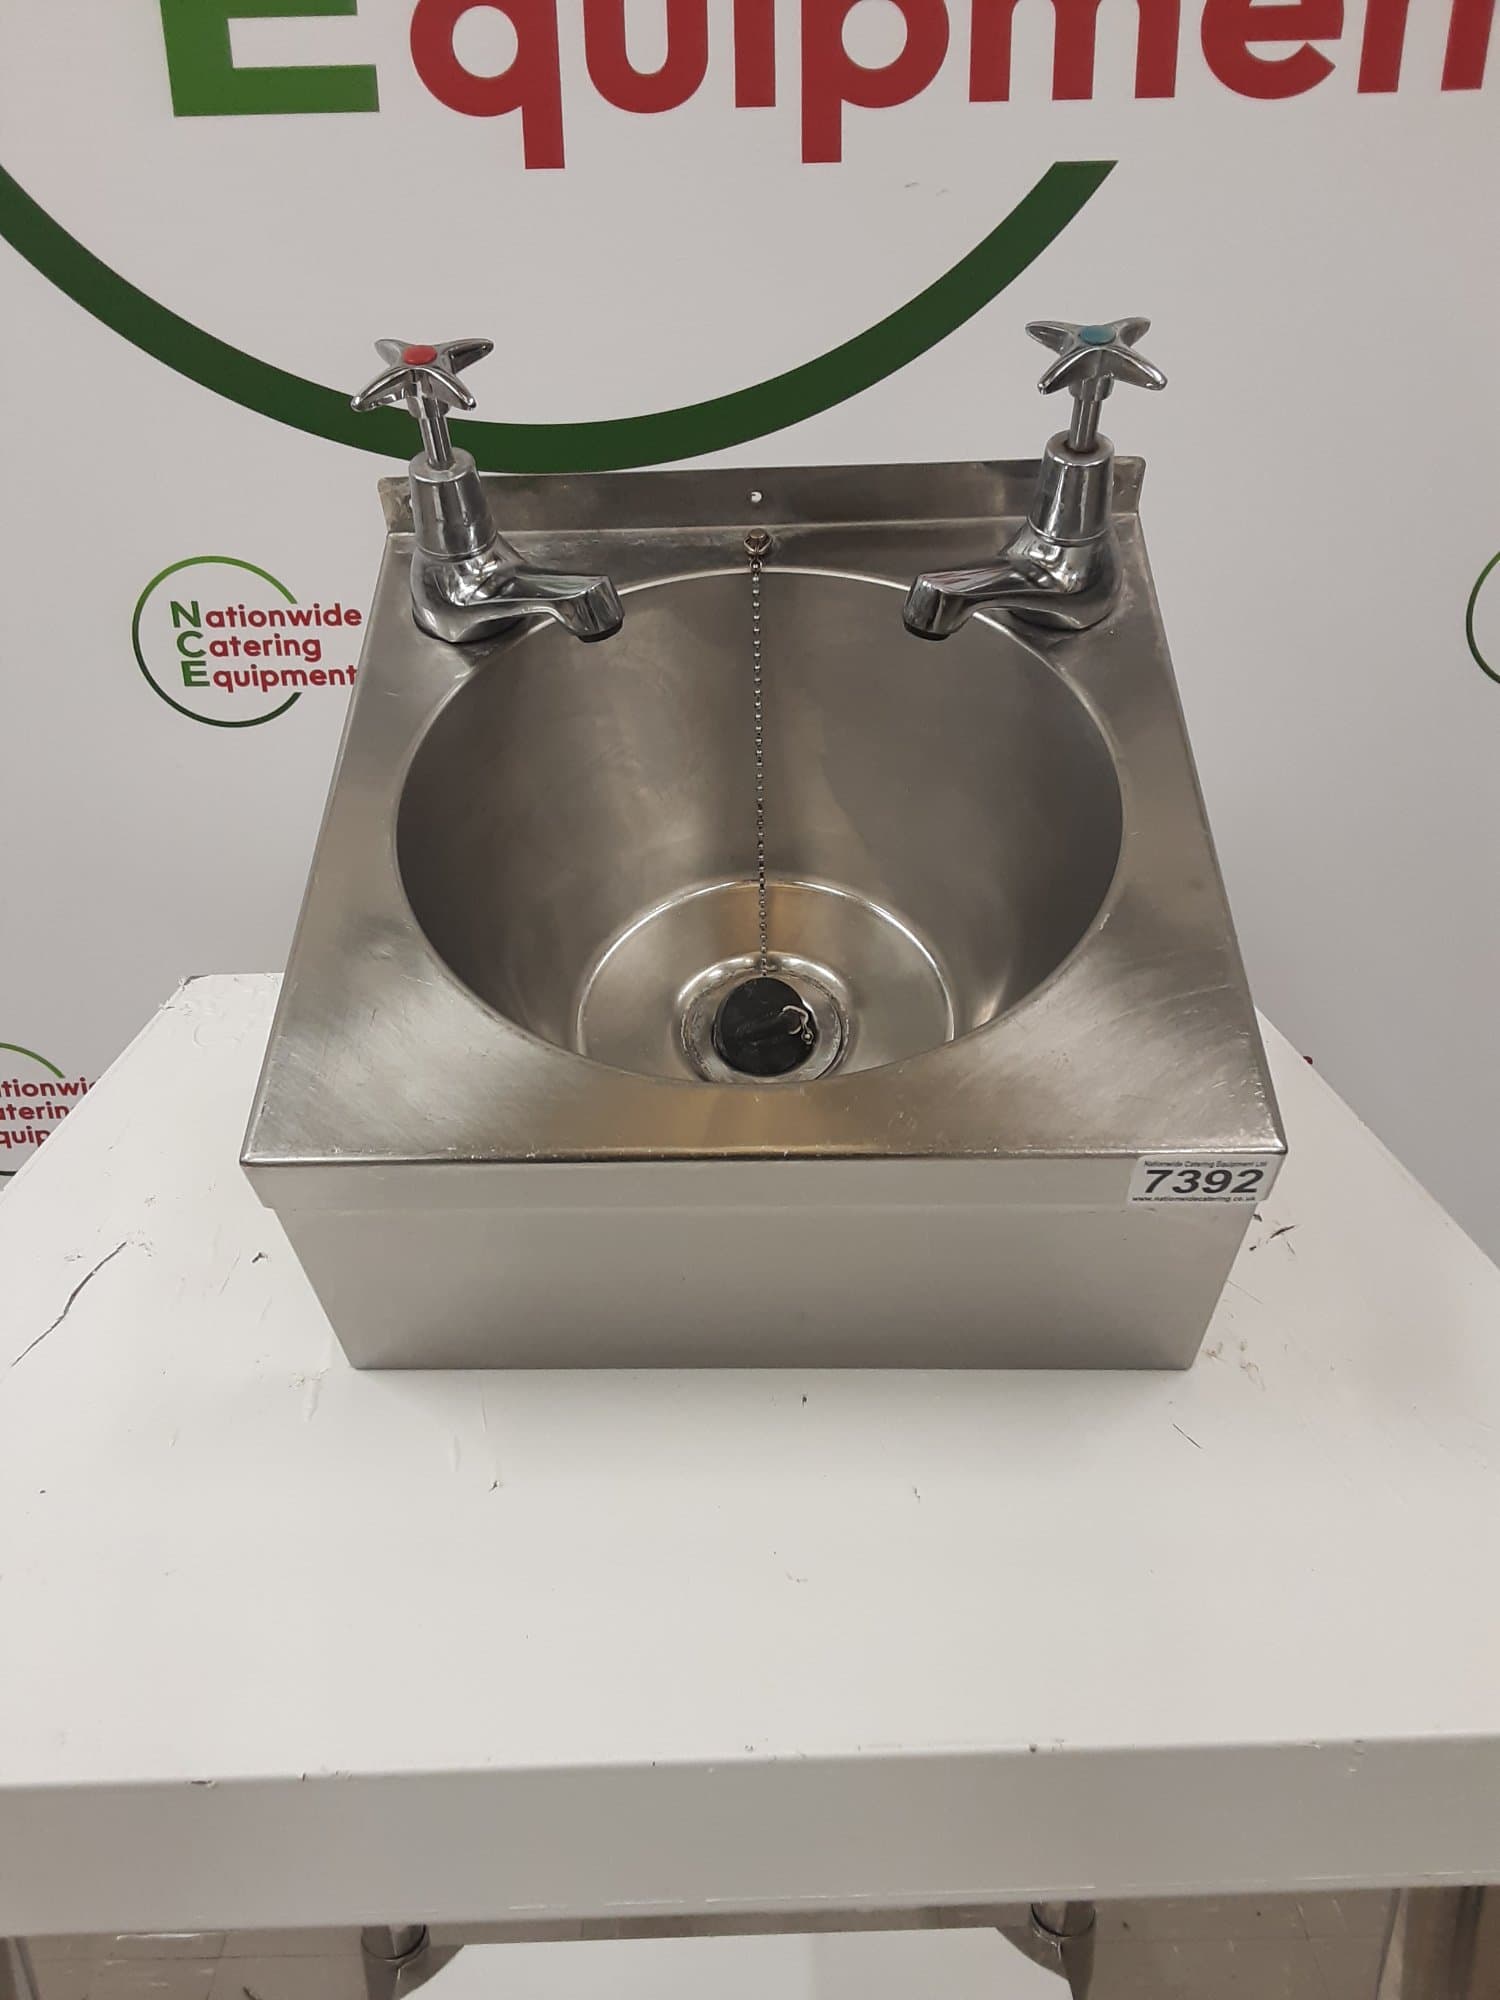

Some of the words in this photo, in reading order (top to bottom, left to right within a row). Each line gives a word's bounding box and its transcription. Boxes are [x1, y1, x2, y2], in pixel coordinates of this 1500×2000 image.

[170, 600, 362, 628] Nationwide
[176, 630, 321, 662] Catering
[180, 660, 357, 693] Equipment
[1145, 1169, 1264, 1194] 7392
